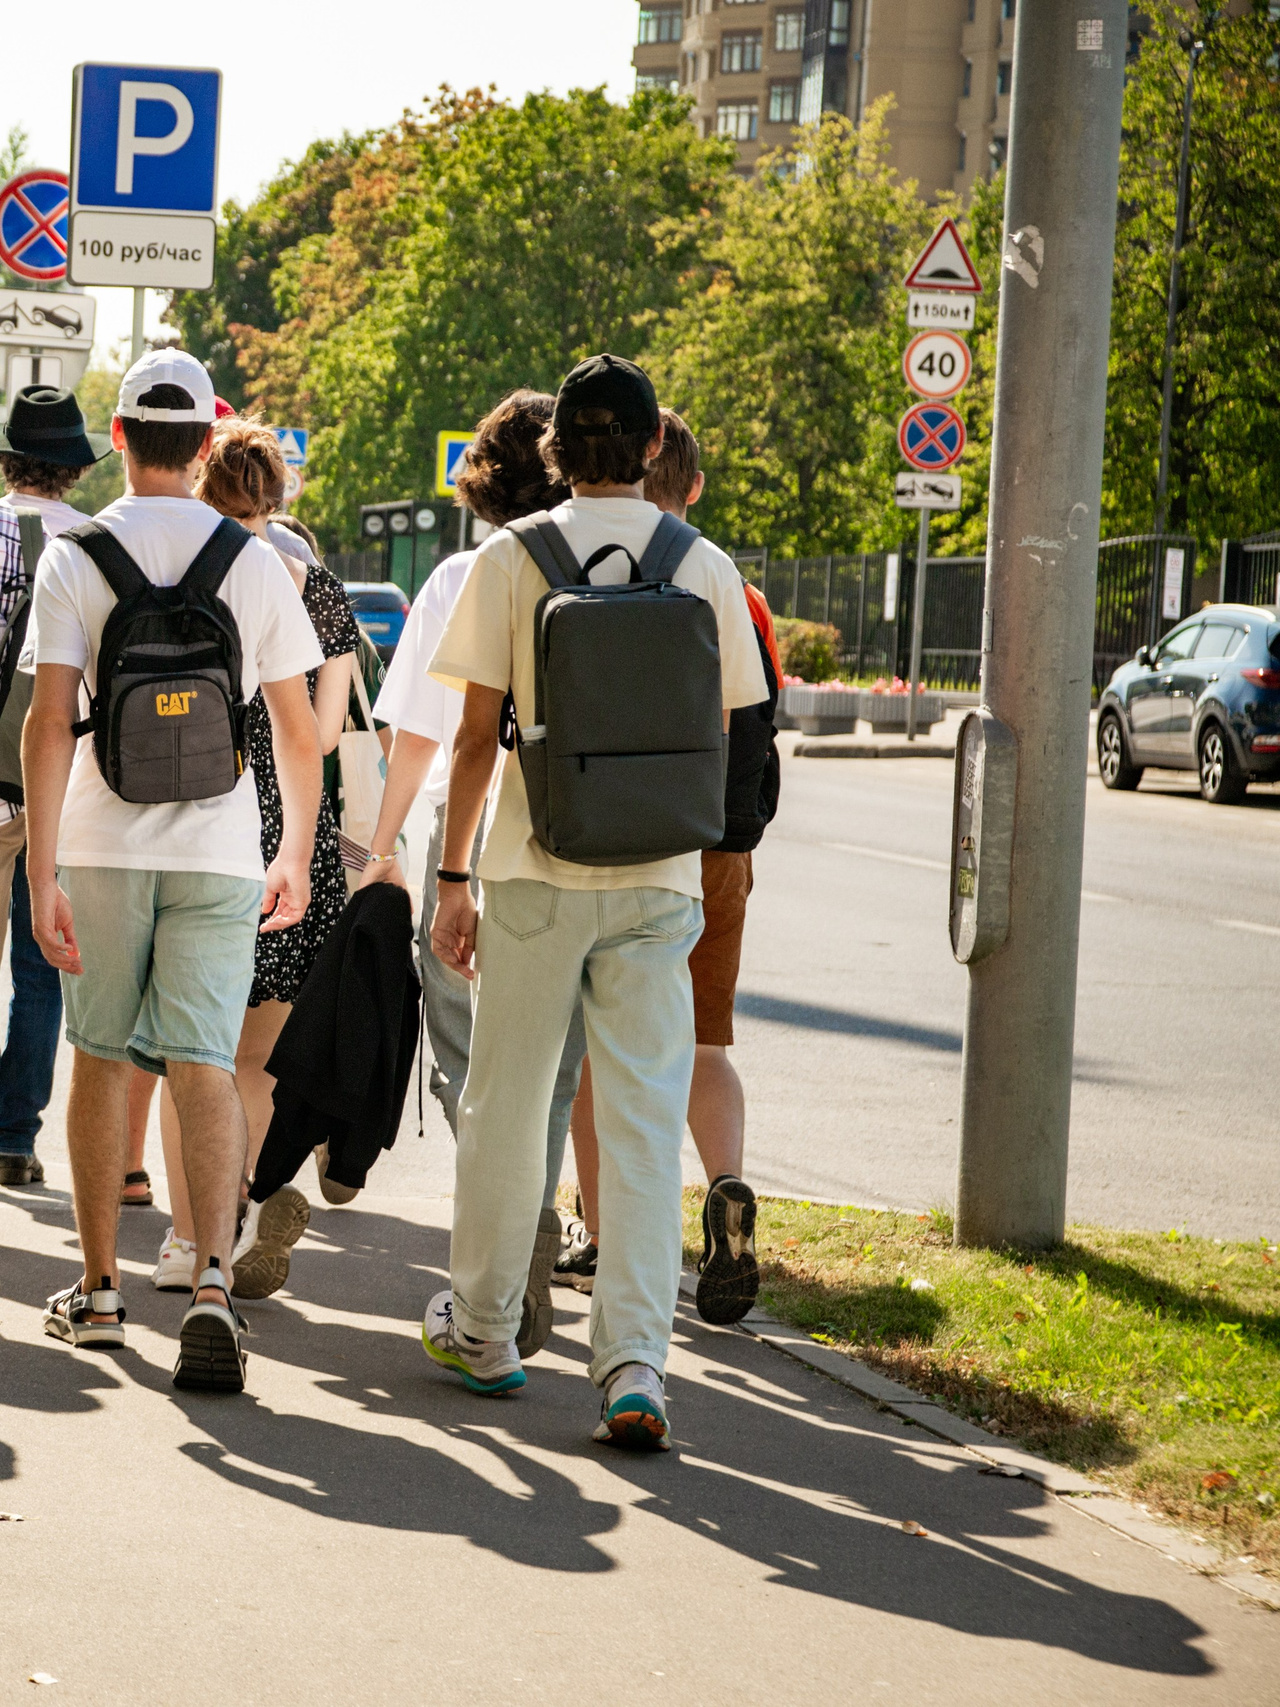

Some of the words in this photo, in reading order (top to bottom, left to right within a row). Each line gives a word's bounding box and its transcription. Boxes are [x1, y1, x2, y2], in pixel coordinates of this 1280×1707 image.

[115, 80, 195, 195] P
[79, 239, 114, 257] 100
[121, 242, 202, 264] руб/час
[918, 351, 956, 378] 40
